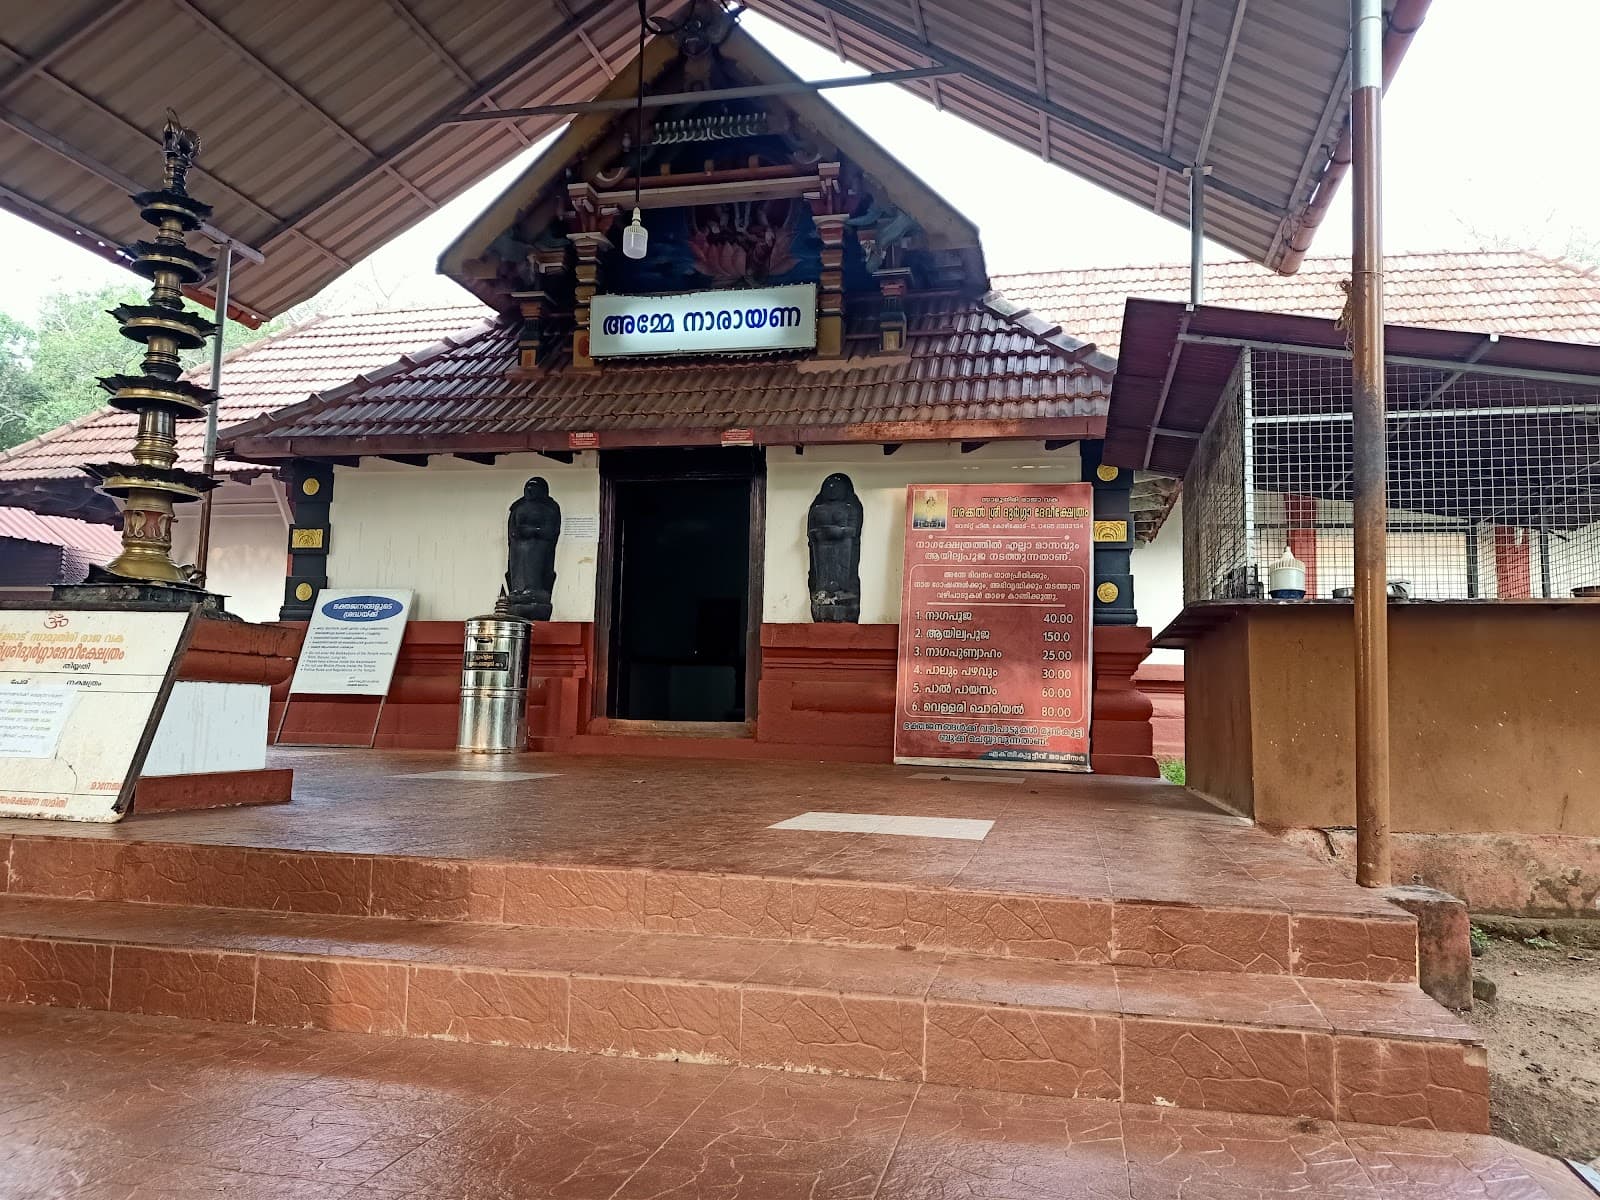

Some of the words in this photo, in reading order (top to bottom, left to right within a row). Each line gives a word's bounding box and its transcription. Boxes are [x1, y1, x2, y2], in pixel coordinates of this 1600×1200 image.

[602, 313, 675, 335] അമ്മേ
[683, 306, 802, 332] നാരായണ
[1006, 540, 1033, 552] എല്ലാ
[1043, 613, 1073, 624] 40.00
[915, 628, 923, 639] 2.
[1042, 631, 1070, 642] 150.0
[913, 646, 923, 657] 3.
[1042, 650, 1072, 661] 25.00
[913, 665, 923, 675] 4.
[925, 666, 958, 679] പാലും
[961, 667, 998, 681] പഴവും
[1042, 669, 1072, 680] 30.00
[912, 683, 922, 694] 5.
[924, 682, 952, 694] പാൽ
[954, 684, 998, 695] പായസം
[1041, 688, 1071, 698] 60.00
[911, 702, 921, 712] 6.
[1041, 707, 1071, 718] 80.00
